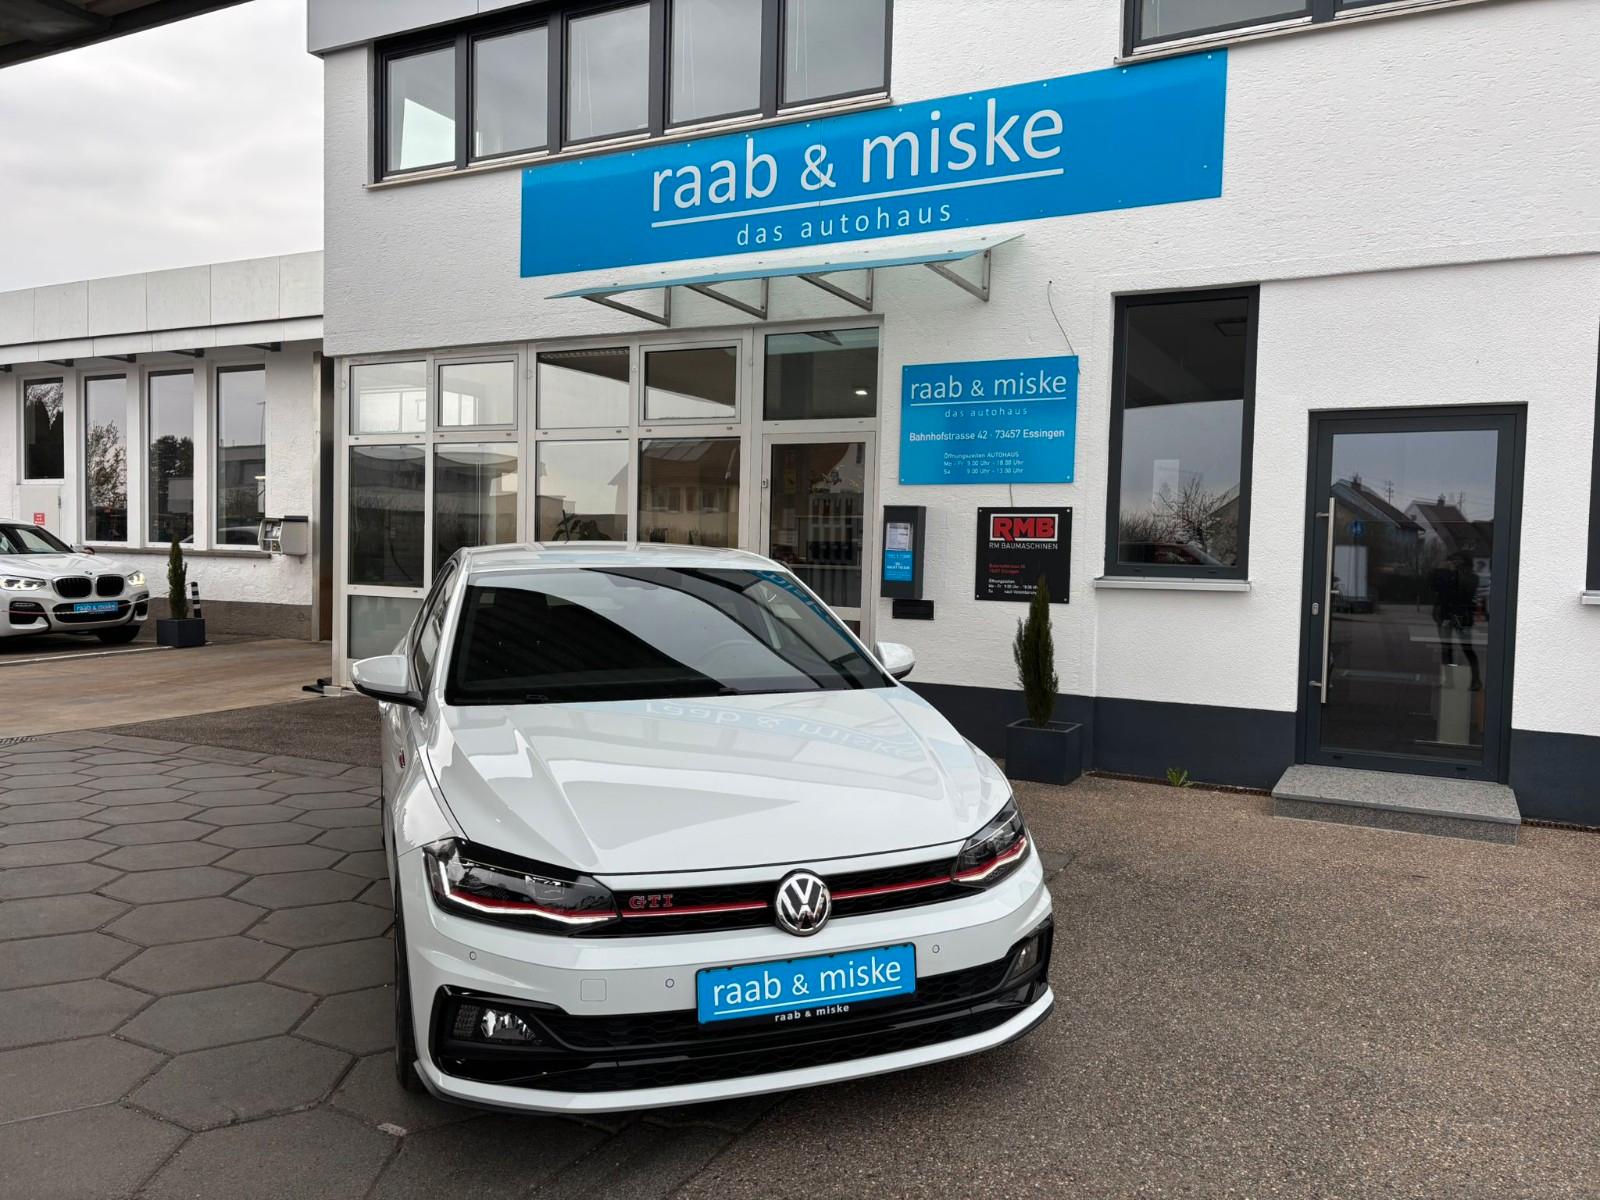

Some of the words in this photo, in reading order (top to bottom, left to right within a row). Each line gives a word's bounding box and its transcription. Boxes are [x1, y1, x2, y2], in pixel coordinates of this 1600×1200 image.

[652, 138, 778, 212] raab
[800, 145, 837, 190] &
[862, 98, 1064, 184] miske
[736, 220, 783, 247] das
[800, 202, 951, 240] autohaus
[910, 375, 963, 400] raab
[970, 379, 985, 397] &
[994, 370, 1067, 396] miske
[944, 408, 965, 418] das
[970, 406, 1028, 417] autohaus
[909, 431, 976, 442] Bahnhofstrasse
[977, 430, 988, 440] 42
[995, 430, 1021, 439] 73457
[1023, 429, 1065, 440] Essingen
[993, 517, 1054, 541] RMB
[1001, 542, 1058, 550] BAUMASCHINEN
[628, 894, 674, 910] GTI
[713, 970, 782, 1007] raab
[792, 973, 810, 996] &
[820, 956, 902, 993] miske
[775, 1011, 801, 1023] raab
[816, 1004, 850, 1017] miske
